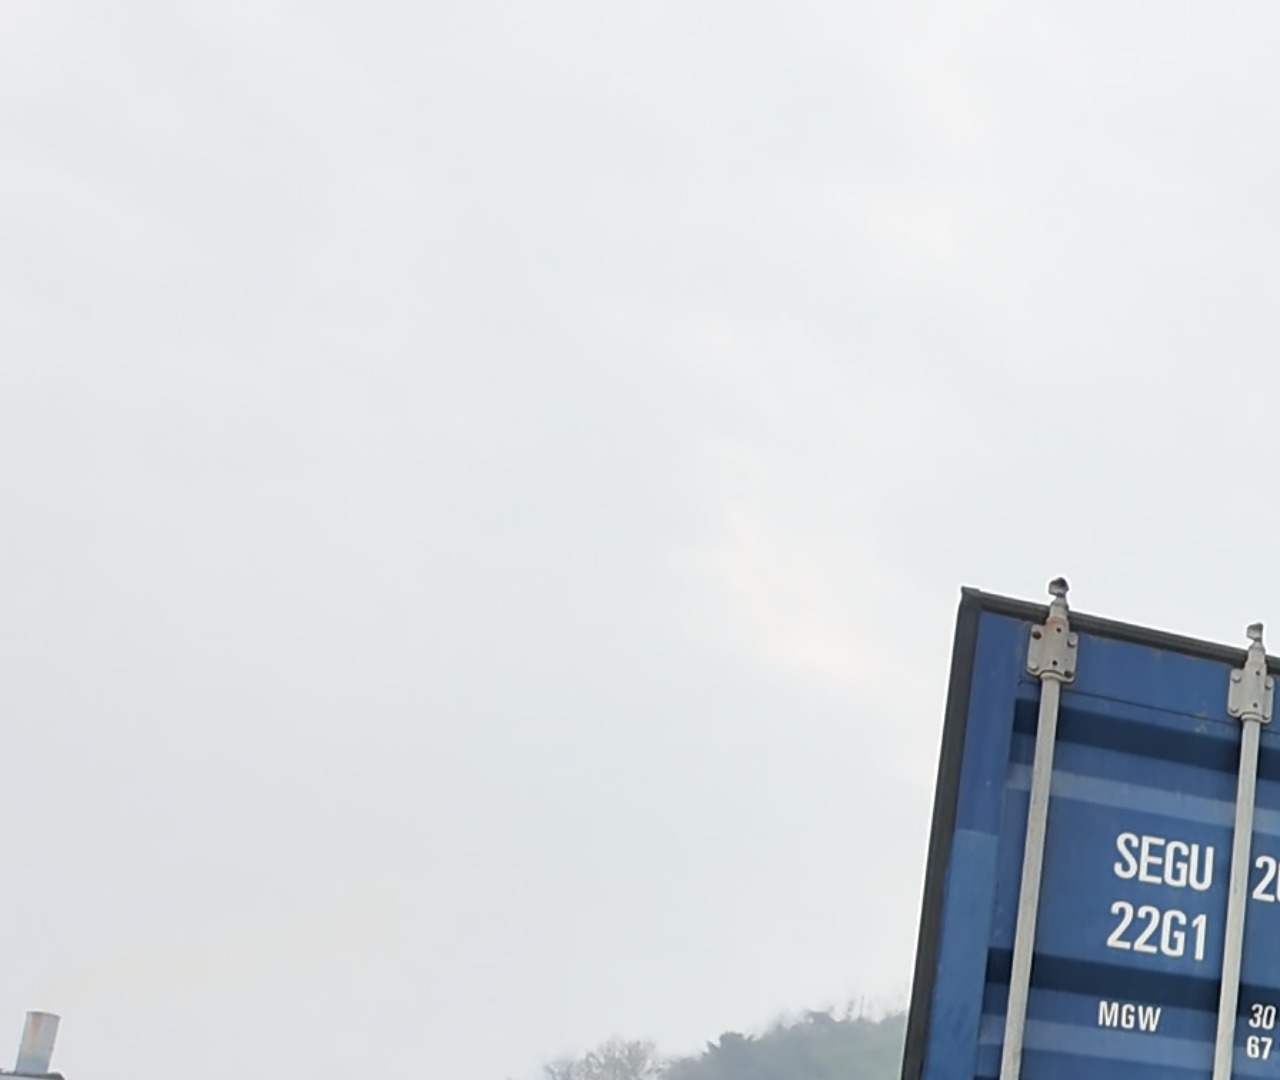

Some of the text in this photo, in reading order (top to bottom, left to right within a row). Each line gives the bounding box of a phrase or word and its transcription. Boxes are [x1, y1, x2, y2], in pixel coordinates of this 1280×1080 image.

[1113, 832, 1214, 891] SEGU
[1106, 901, 1207, 961] 22G1
[1098, 1000, 1161, 1032] MGW
[1248, 1004, 1276, 1030] 30
[1246, 1035, 1273, 1060] 67
